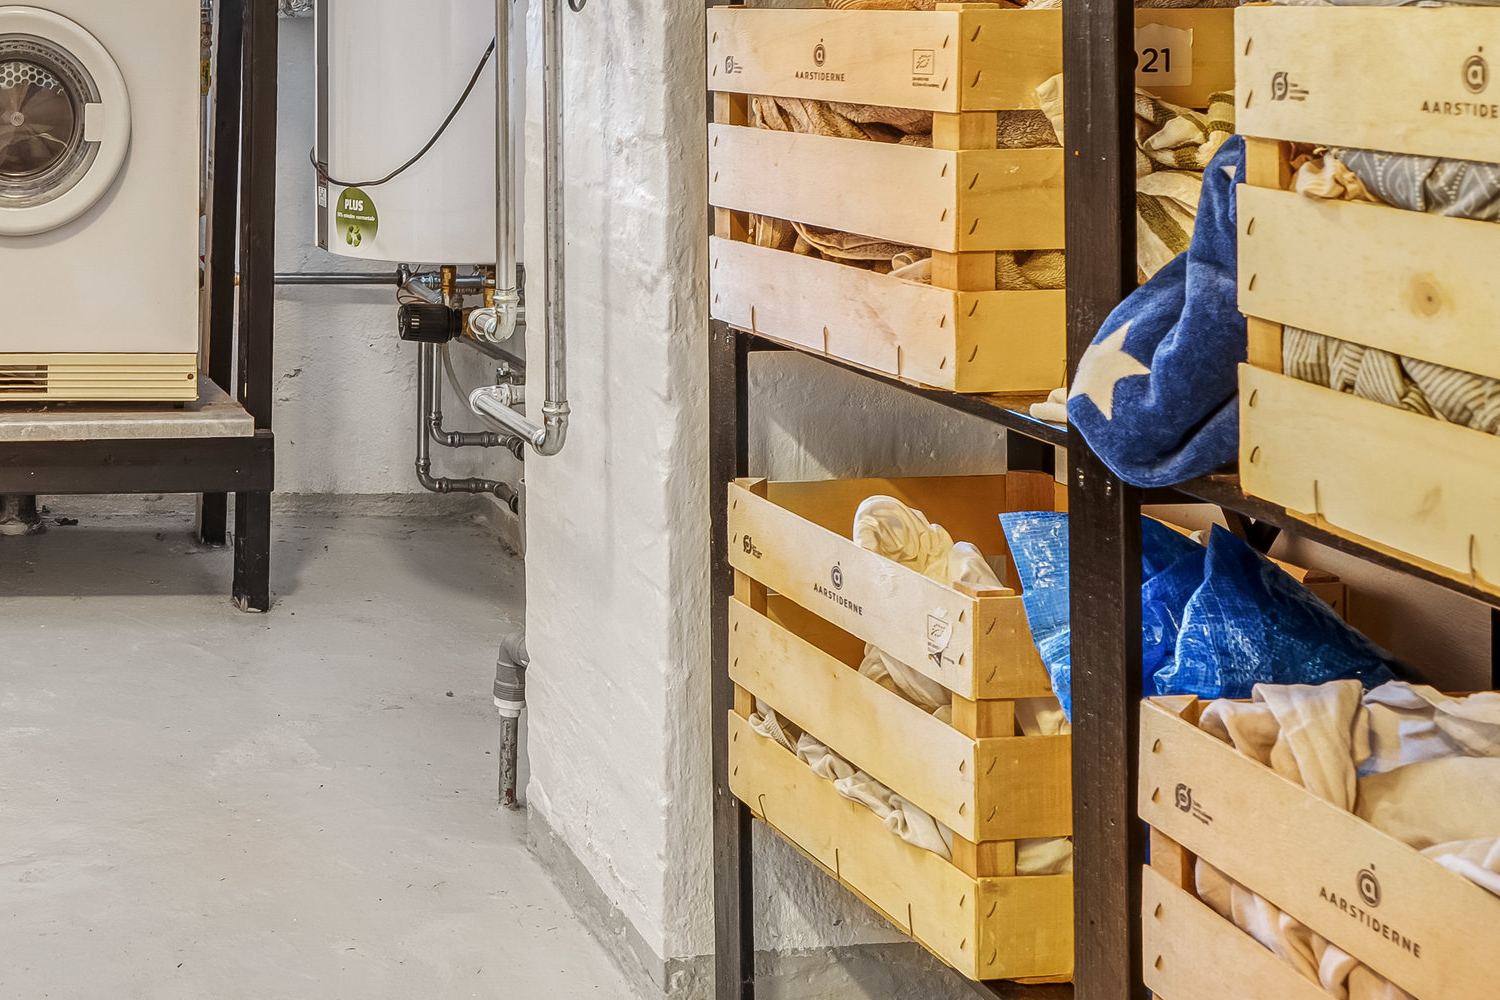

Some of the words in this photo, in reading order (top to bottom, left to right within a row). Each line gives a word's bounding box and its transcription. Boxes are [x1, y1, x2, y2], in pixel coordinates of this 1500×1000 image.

[1134, 47, 1170, 73] 21
[795, 71, 845, 82] AARSTIDERNE
[344, 198, 364, 212] PLUS
[813, 583, 863, 616] AARSTIDERNE
[1319, 886, 1421, 959] AARSTIDERNE
